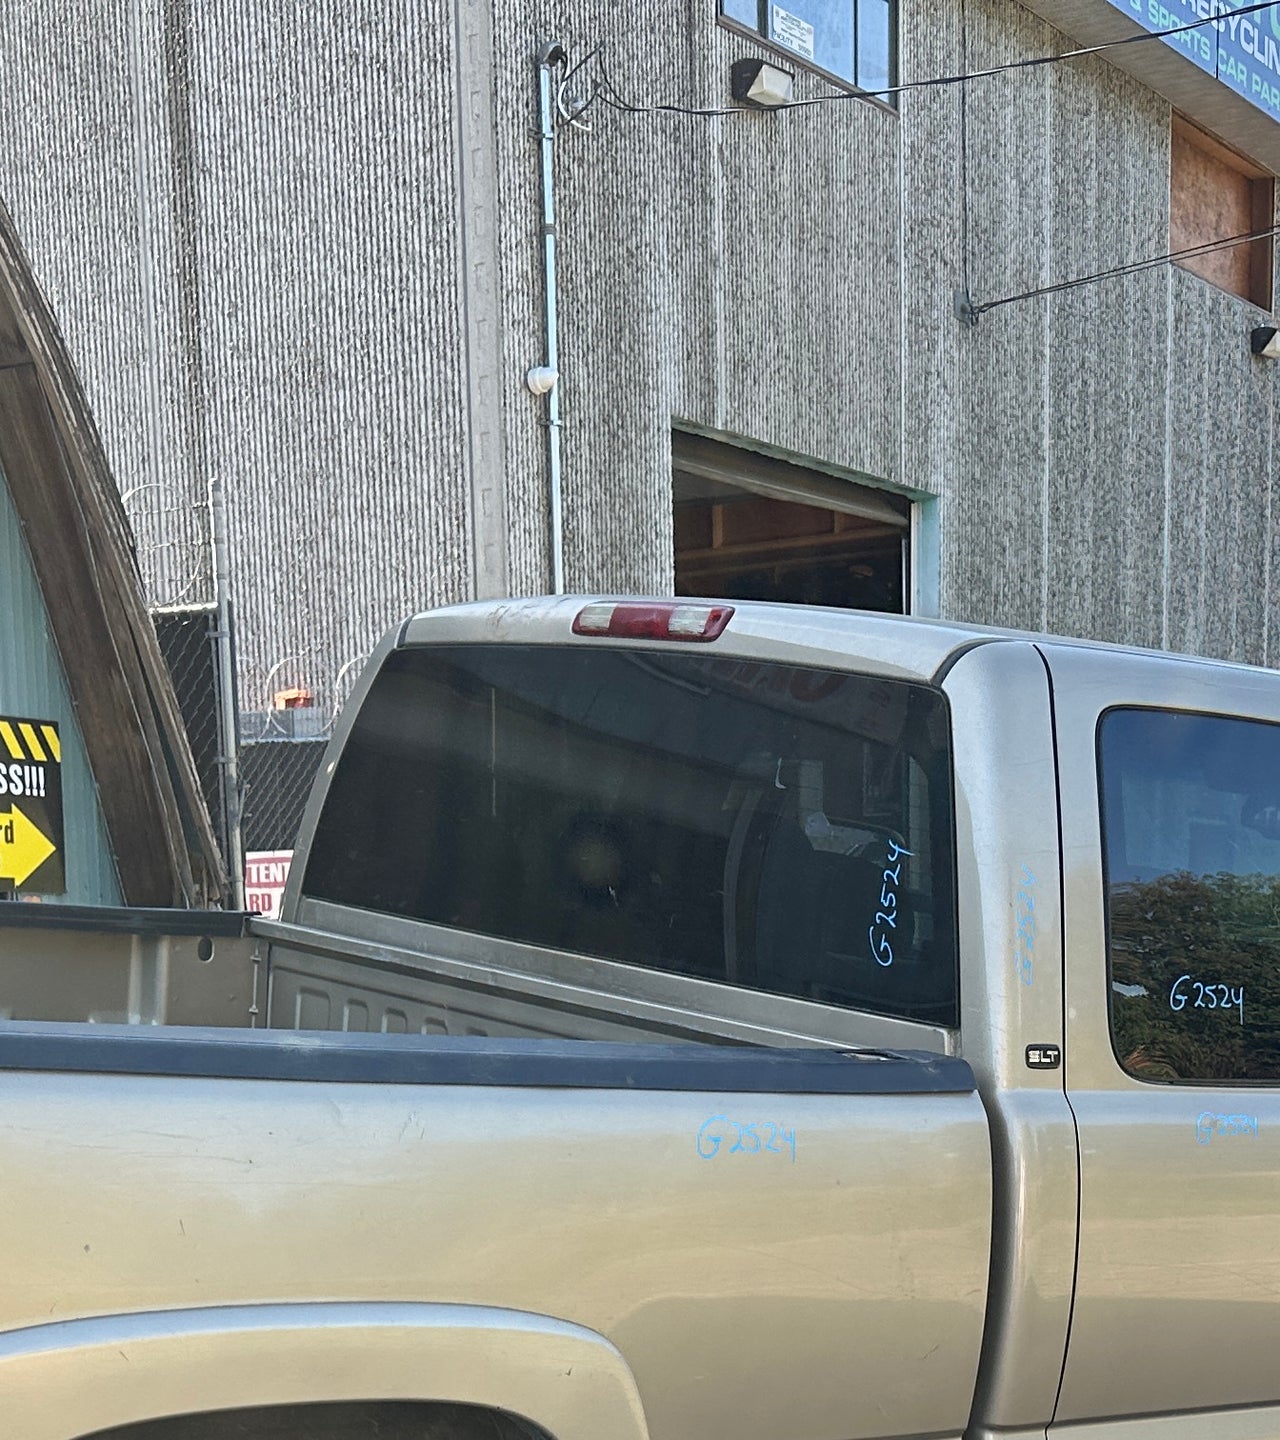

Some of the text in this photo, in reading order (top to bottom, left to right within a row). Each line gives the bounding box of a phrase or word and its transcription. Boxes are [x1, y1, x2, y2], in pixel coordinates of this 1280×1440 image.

[1218, 52, 1247, 88] CAR
[869, 838, 915, 967] G2524
[1169, 975, 1245, 1025] G2524
[1028, 1050, 1059, 1063] SLT
[697, 1114, 797, 1164] G2524
